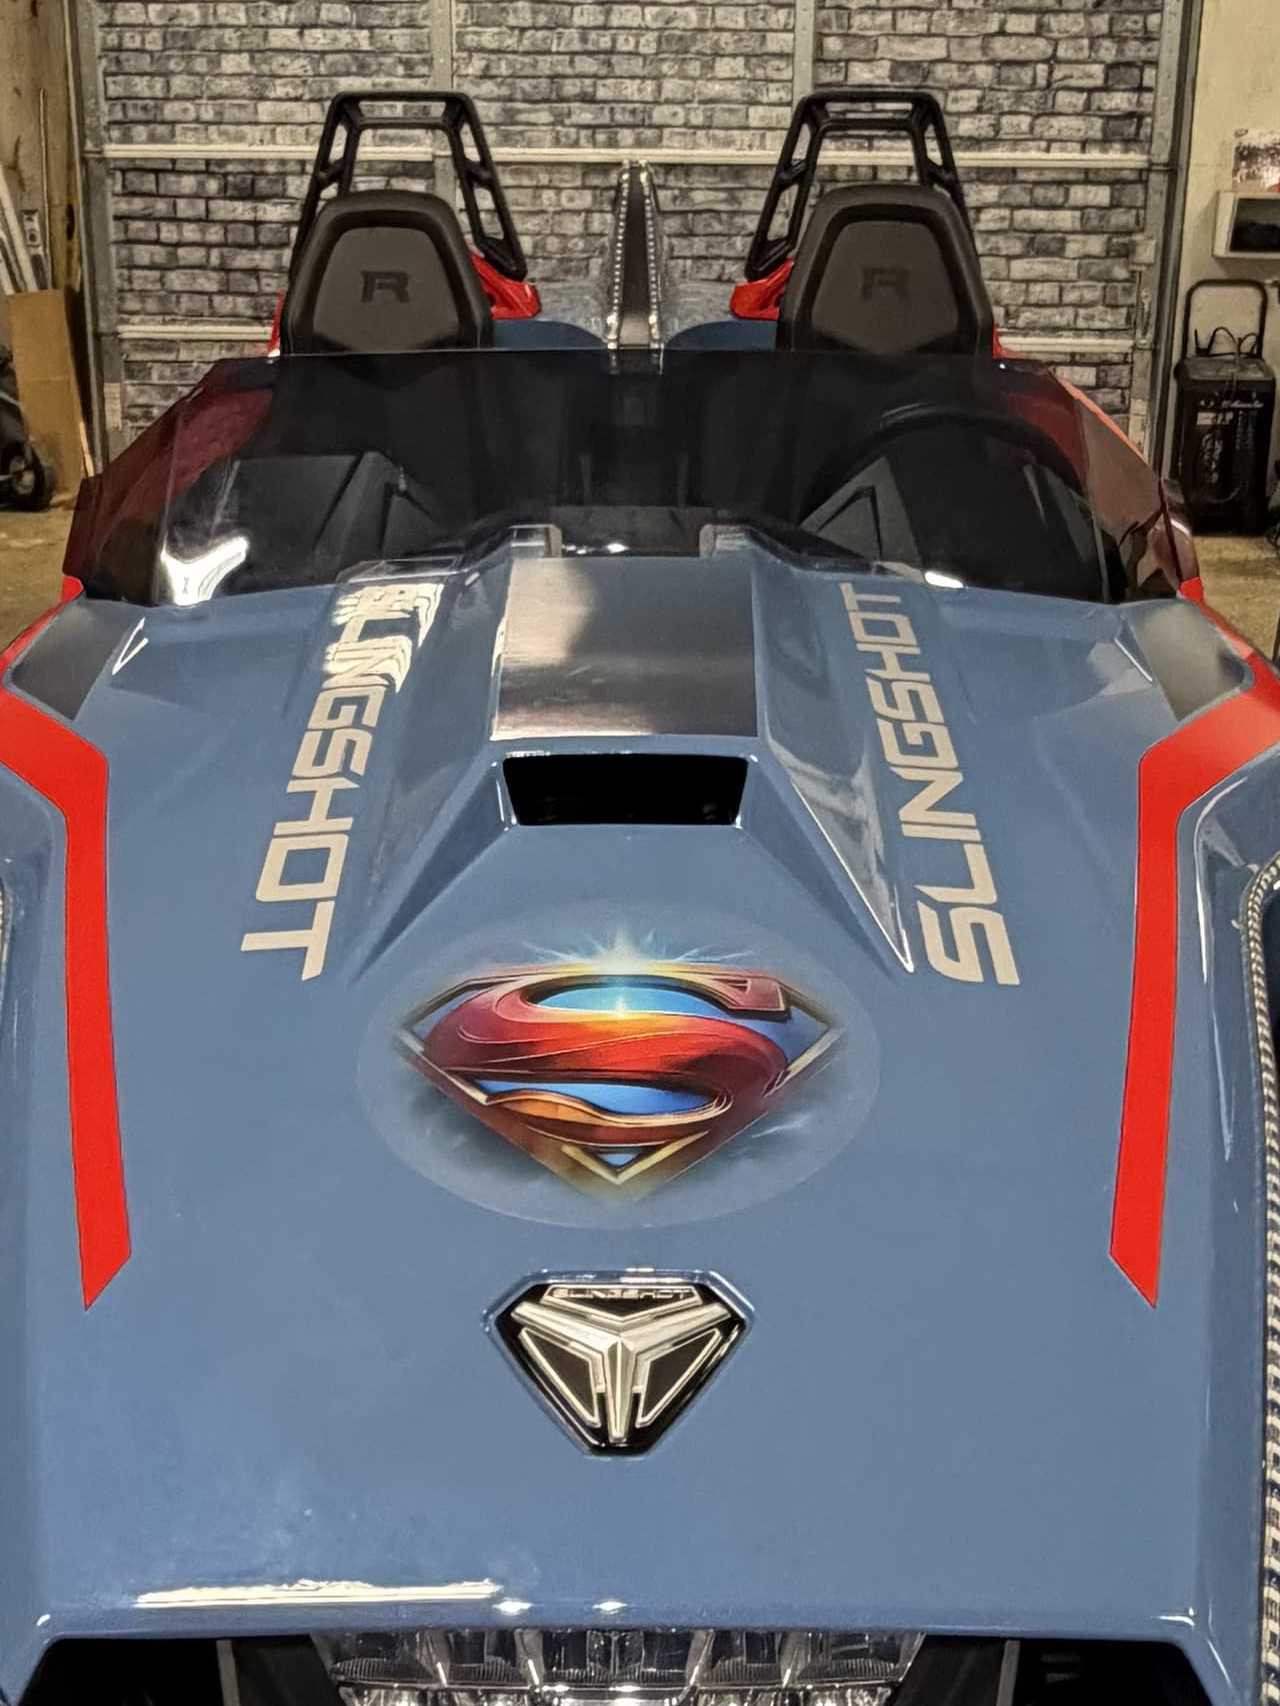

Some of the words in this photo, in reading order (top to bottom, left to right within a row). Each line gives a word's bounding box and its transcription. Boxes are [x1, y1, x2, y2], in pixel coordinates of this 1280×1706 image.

[360, 270, 411, 303] R
[861, 267, 911, 301] R
[241, 583, 425, 981] SLINGSHOT
[839, 583, 1020, 985] SLINGSHOT
[552, 1288, 691, 1300] SLINGSHOT
